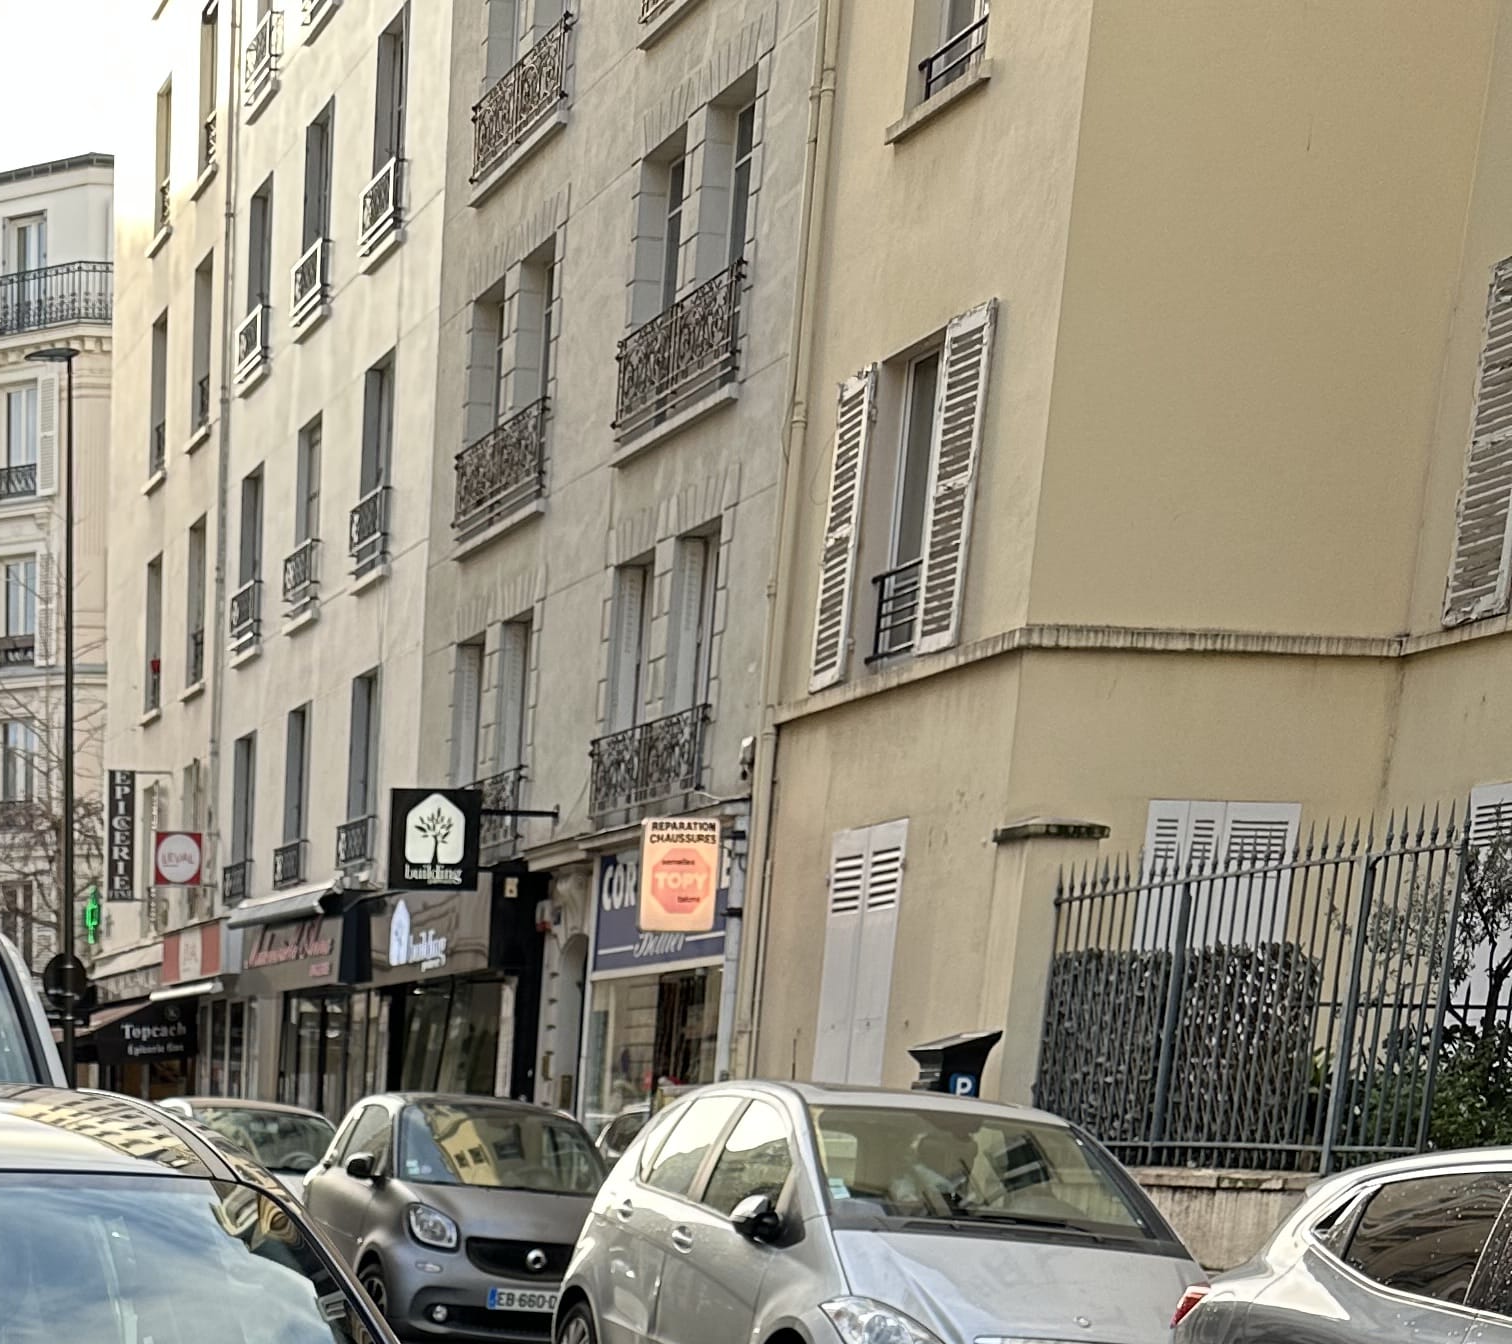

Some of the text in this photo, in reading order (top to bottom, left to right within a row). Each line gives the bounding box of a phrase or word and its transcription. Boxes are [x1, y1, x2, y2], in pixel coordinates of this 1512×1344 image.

[652, 821, 716, 832] REPARATION
[650, 833, 716, 844] CHAUSSURES
[404, 863, 463, 885] building
[654, 871, 707, 890] TOPY
[955, 1076, 972, 1096] P
